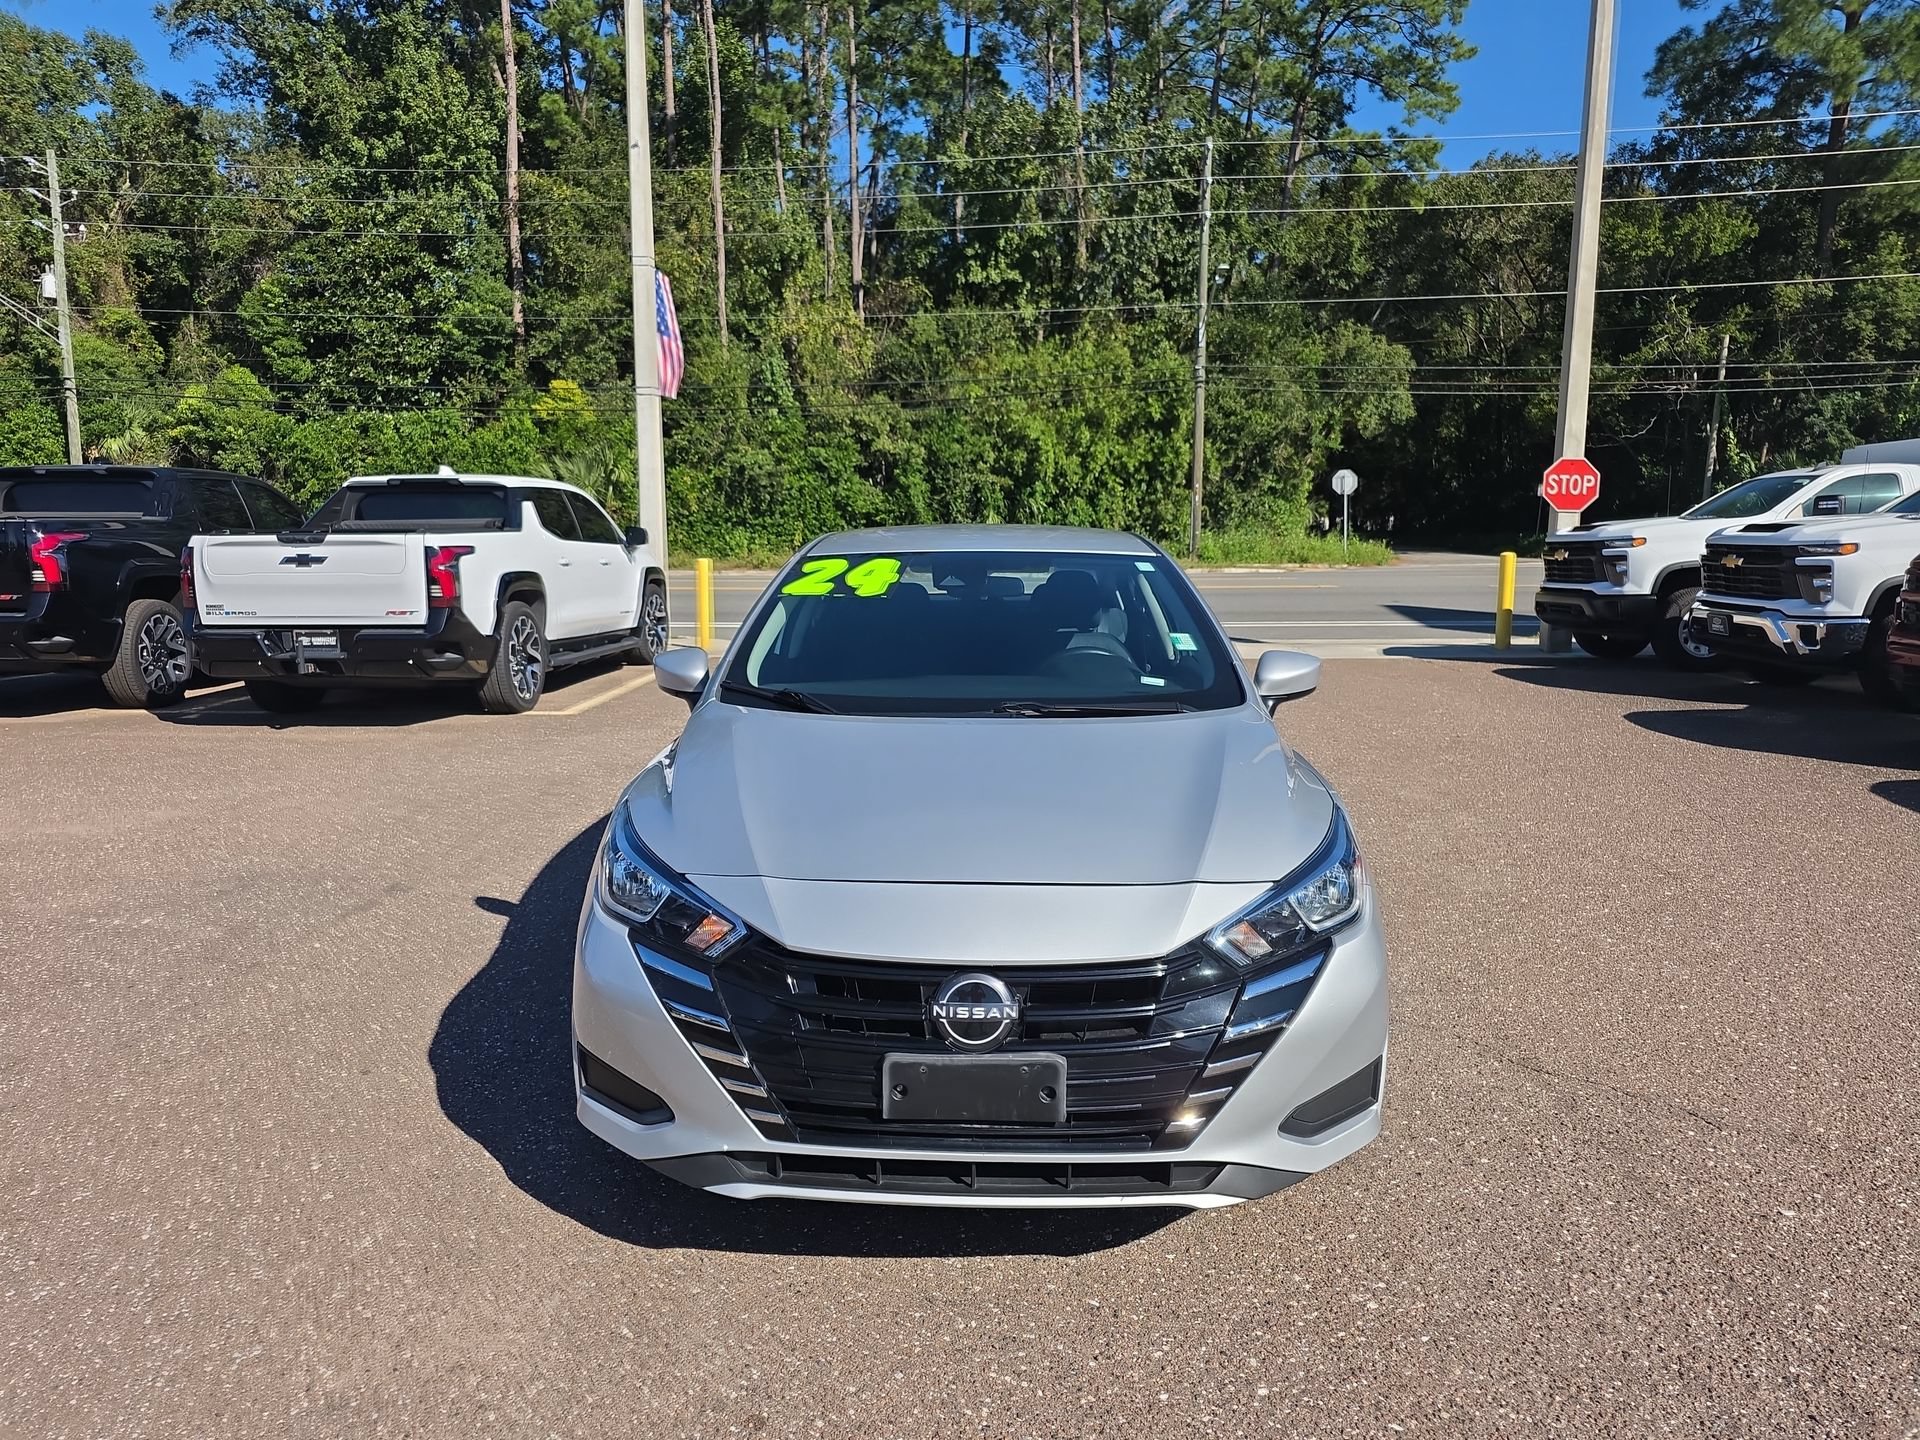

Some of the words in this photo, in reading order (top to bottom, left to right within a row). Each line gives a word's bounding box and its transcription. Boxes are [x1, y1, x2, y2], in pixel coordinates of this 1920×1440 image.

[1546, 474, 1596, 496] STOP
[781, 558, 902, 597] 24
[932, 1004, 1017, 1019] NISSAN
